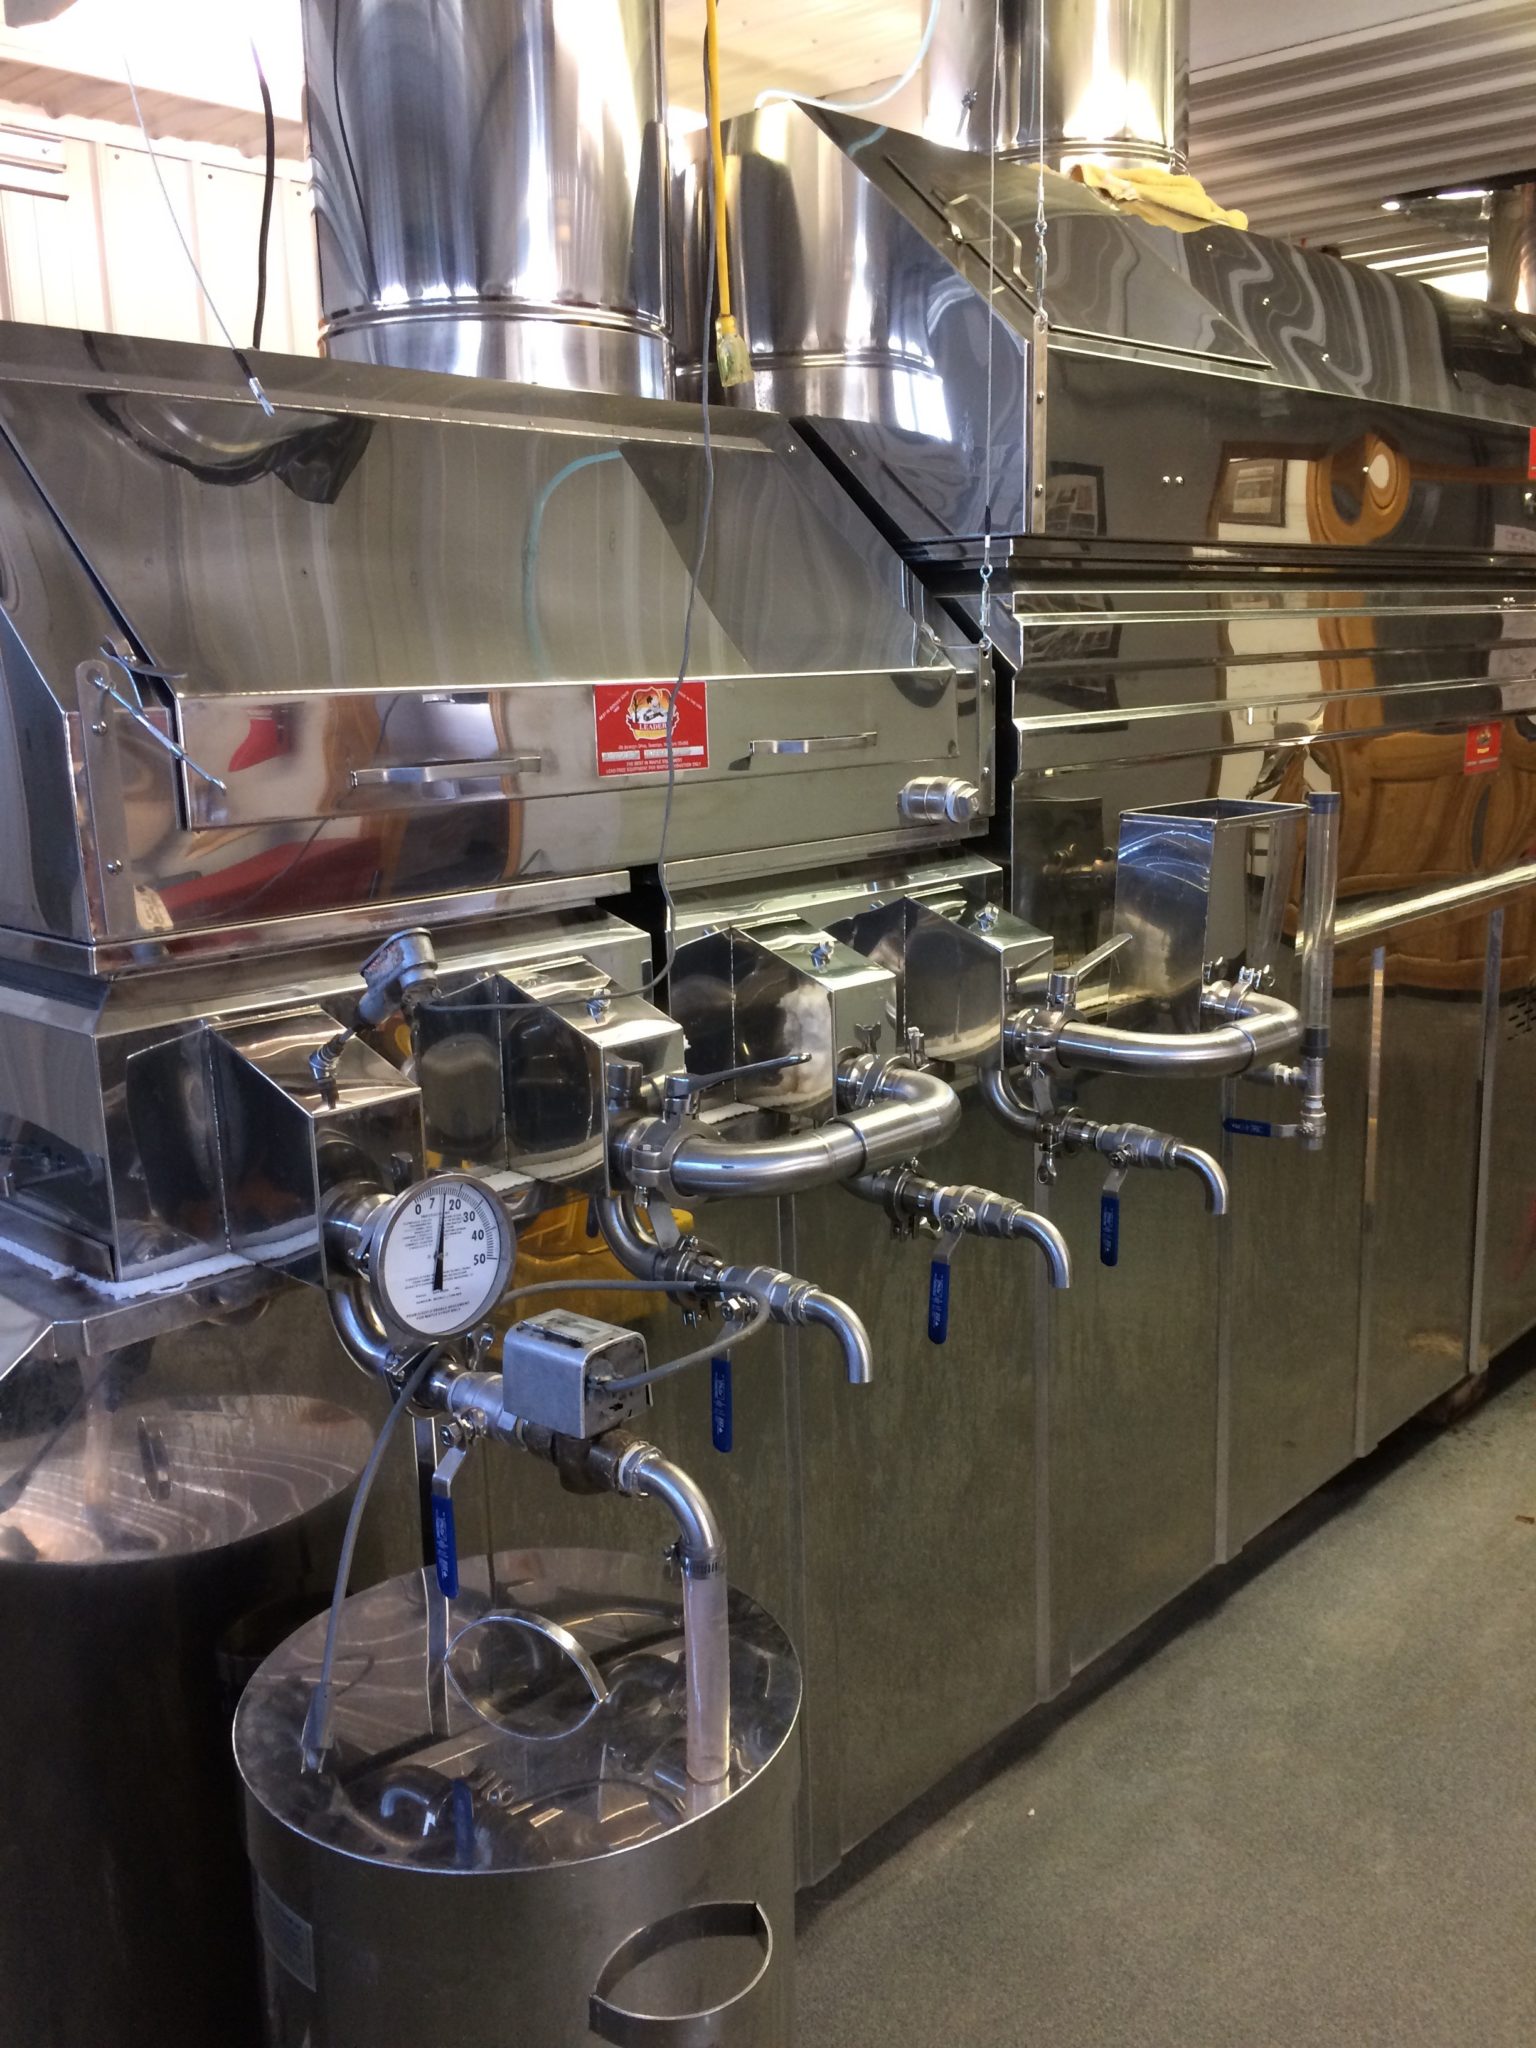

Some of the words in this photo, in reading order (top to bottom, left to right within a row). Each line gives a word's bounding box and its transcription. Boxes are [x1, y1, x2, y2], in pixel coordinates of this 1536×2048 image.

[639, 722, 667, 730] LEADER
[429, 1197, 435, 1209] 7
[449, 1199, 461, 1210] 20
[415, 1204, 421, 1215] 0
[463, 1210, 475, 1222] 30
[471, 1229, 484, 1241] 40
[473, 1253, 485, 1266] 50
